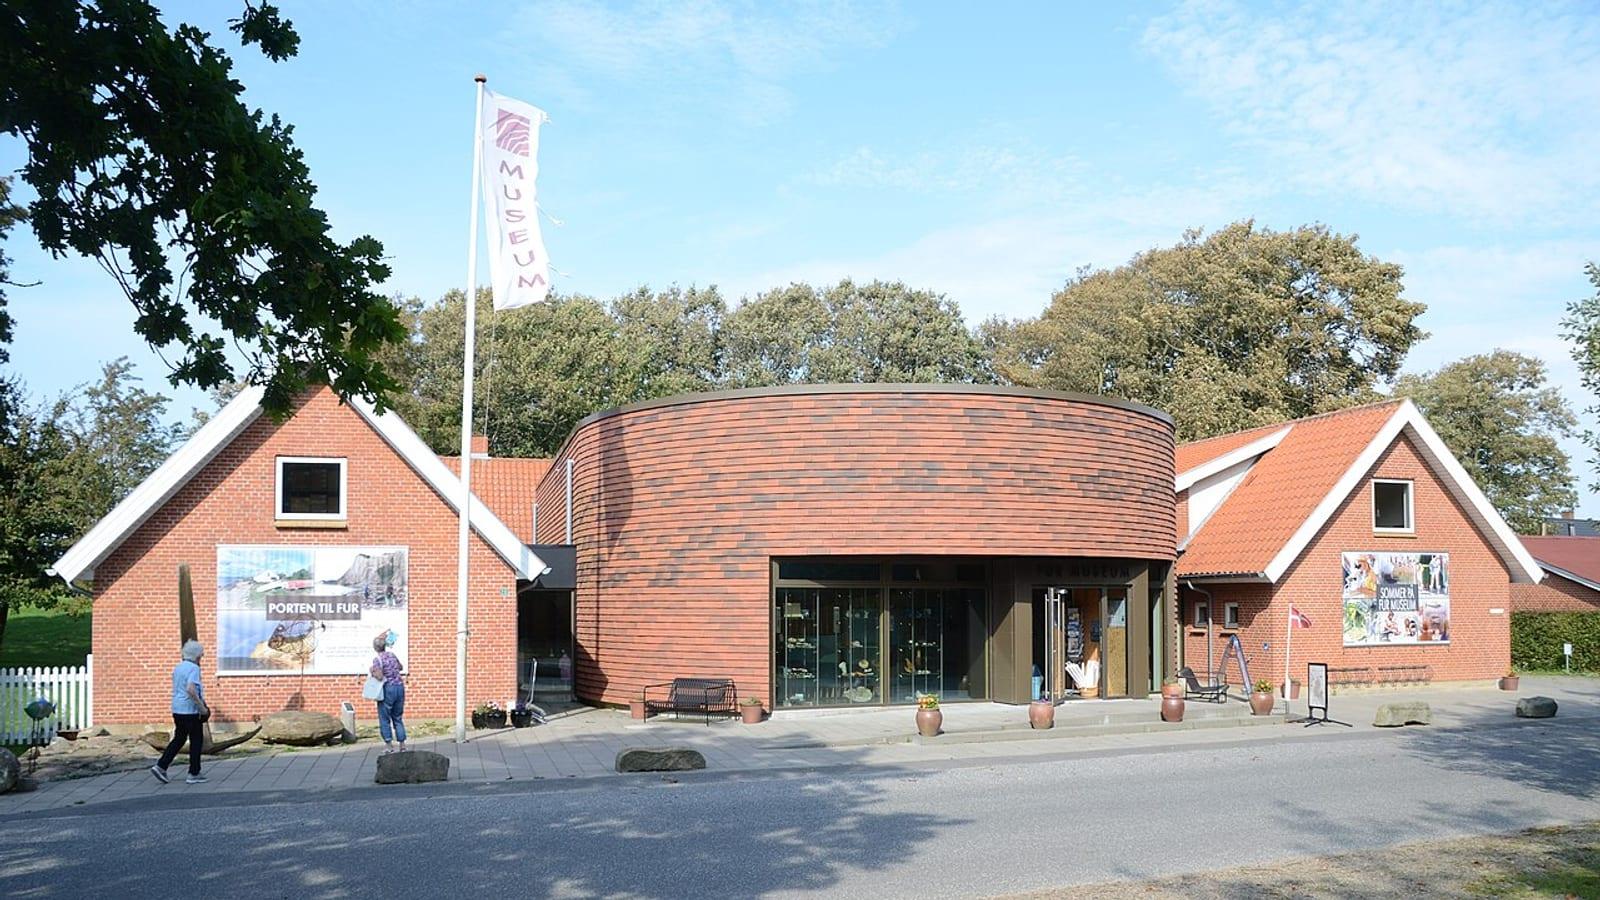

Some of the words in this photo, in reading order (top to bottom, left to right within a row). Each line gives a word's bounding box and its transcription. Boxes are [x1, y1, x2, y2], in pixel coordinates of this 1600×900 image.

[499, 160, 546, 288] MUSEUM
[1071, 566, 1130, 578] MUSEUM
[1380, 586, 1407, 599] SOMMER
[268, 602, 316, 614] PORTEN
[318, 602, 334, 614] TIL
[336, 602, 359, 614] FUR
[1378, 599, 1389, 610] FUR
[1390, 599, 1416, 610] MUSEUM
